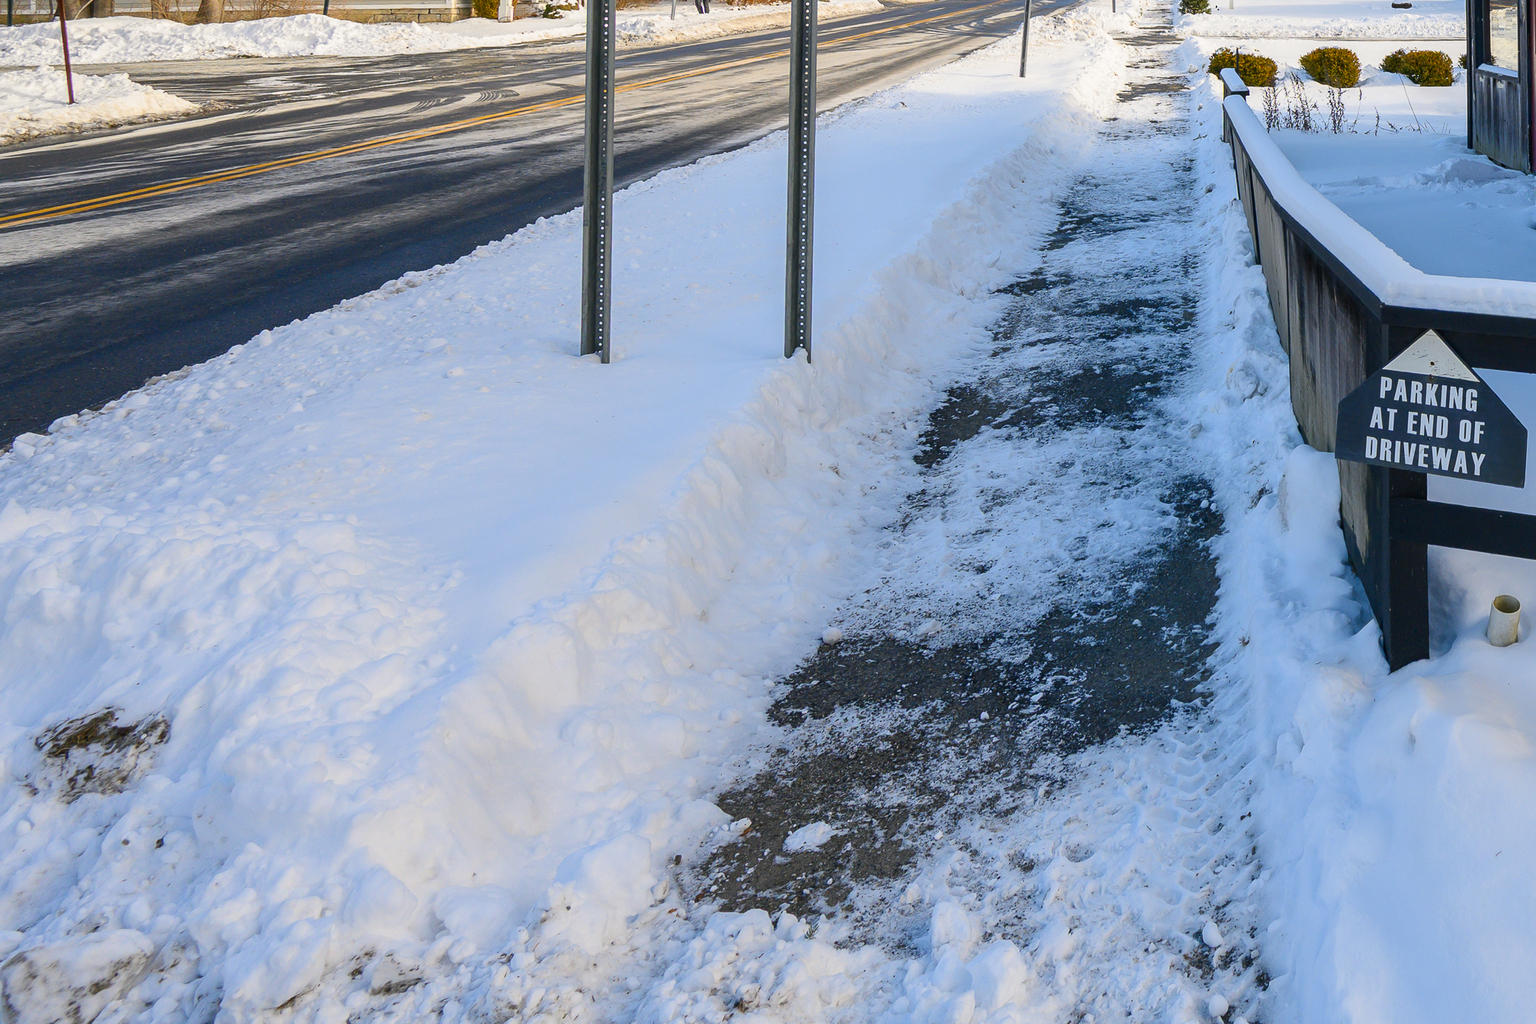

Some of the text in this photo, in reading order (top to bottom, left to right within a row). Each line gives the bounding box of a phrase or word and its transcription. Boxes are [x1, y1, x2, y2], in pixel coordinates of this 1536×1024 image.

[1379, 376, 1478, 412] PARKING
[1369, 406, 1486, 444] AT END OF
[1365, 436, 1486, 476] DRIVEWAY
